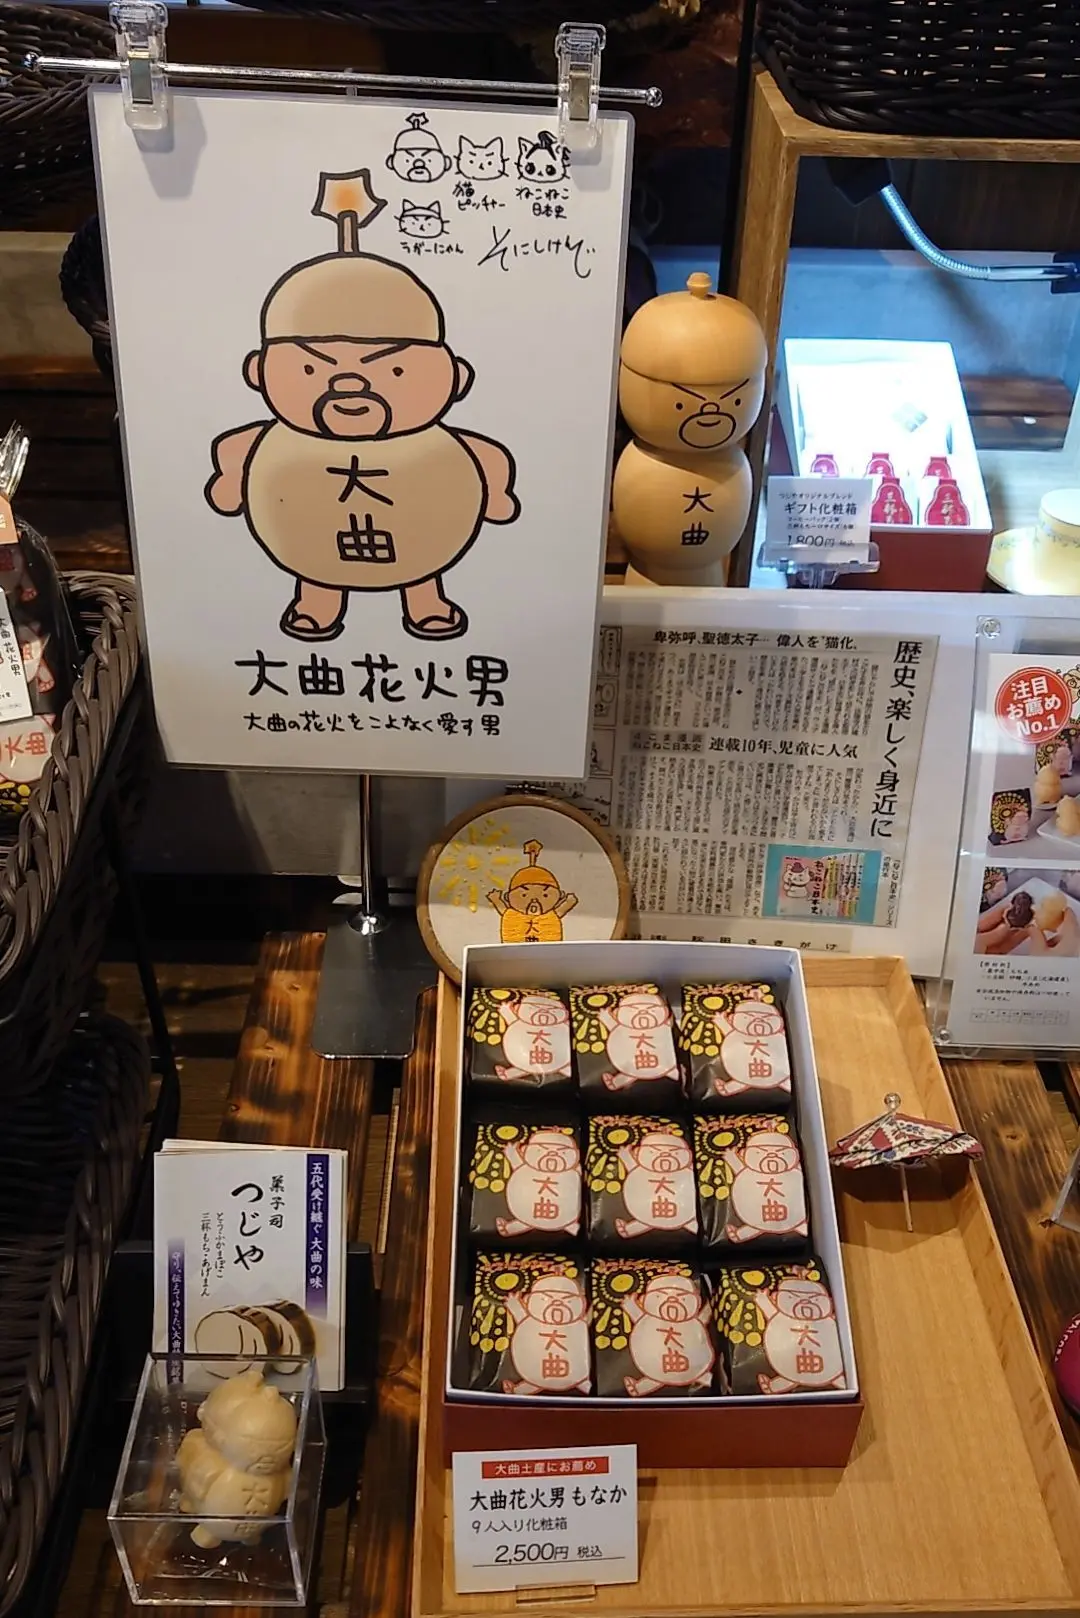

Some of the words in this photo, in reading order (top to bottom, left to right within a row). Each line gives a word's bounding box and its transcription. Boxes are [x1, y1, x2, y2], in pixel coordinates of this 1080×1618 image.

[452, 181, 475, 197] 猫
[457, 196, 506, 211] ピッチャー
[515, 186, 570, 200] ねこねこ
[532, 202, 567, 219] 日本史
[400, 242, 464, 254] ラガーにゃん
[326, 455, 397, 564] 大曲
[680, 486, 715, 547] 大曲
[784, 501, 858, 515] ギフト化粧箱
[234, 650, 509, 707] 大曲花火男
[1010, 675, 1049, 701] 注目
[243, 711, 502, 736] 大曲の花火をこよなく愛す男
[1006, 695, 1062, 721] お薦め
[1016, 715, 1060, 738] No.1
[5, 732, 48, 761] 大曲
[708, 736, 859, 759] 連載10年、児童に人気
[870, 640, 923, 838] 歴史、楽しく身近に
[526, 1028, 554, 1066] 大曲
[629, 1032, 660, 1071] 大曲
[744, 1039, 773, 1079] 大曲
[268, 1174, 286, 1229] 菓子司
[532, 1176, 560, 1220] 大曲
[648, 1176, 677, 1220] 大曲
[756, 1177, 788, 1223] 大曲
[231, 1182, 265, 1271] つじや
[309, 1162, 325, 1289] 五代受け継ぐ大曲の味
[538, 1329, 570, 1379] 大曲
[656, 1326, 690, 1373] 大曲
[790, 1324, 825, 1374] 大曲
[494, 1460, 597, 1476] 大曲土産にお薦め
[471, 1517, 568, 1534] 9人入り化粧箱
[494, 1542, 570, 1565] 2,500円
[577, 1545, 603, 1559] 税込
